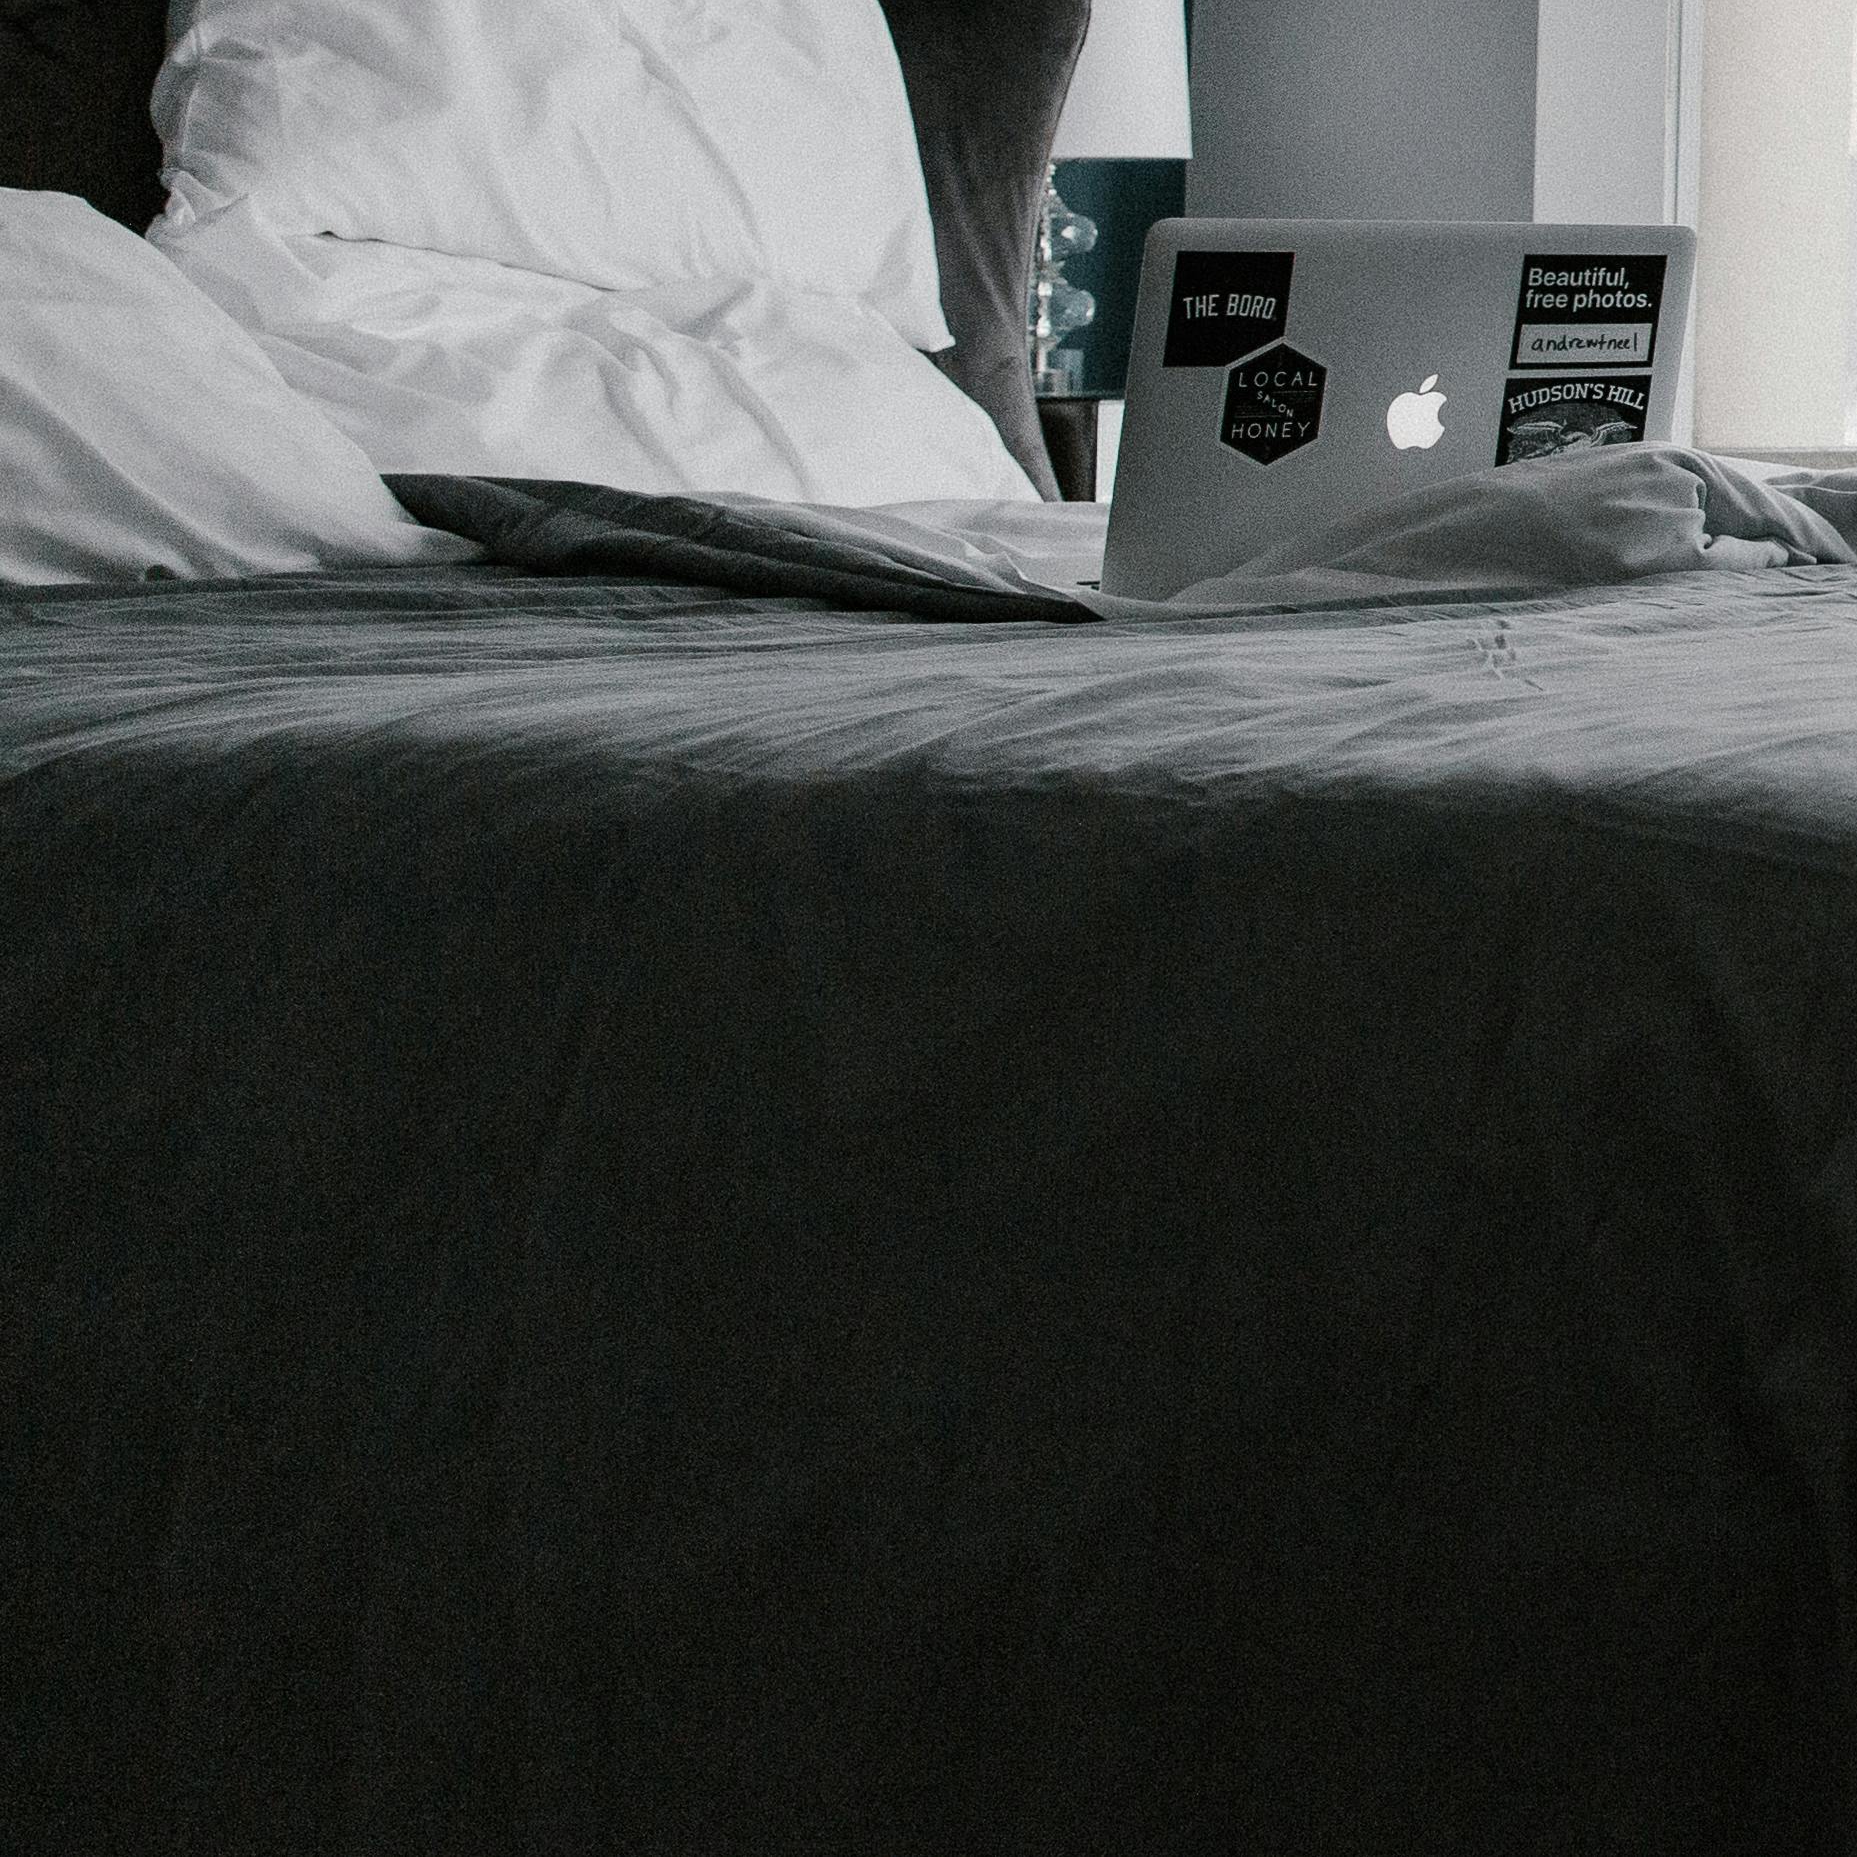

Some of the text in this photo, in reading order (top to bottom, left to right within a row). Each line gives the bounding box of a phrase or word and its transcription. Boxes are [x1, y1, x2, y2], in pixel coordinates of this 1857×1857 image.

[1528, 267, 1630, 290] Beautiful,
[1182, 294, 1220, 320] THE
[1525, 289, 1653, 313] free photos.
[1238, 371, 1318, 388] LOCAL
[1256, 390, 1294, 418] SALON
[1507, 382, 1646, 414] HUDSON'S HILL
[1231, 421, 1311, 439] HONEY
